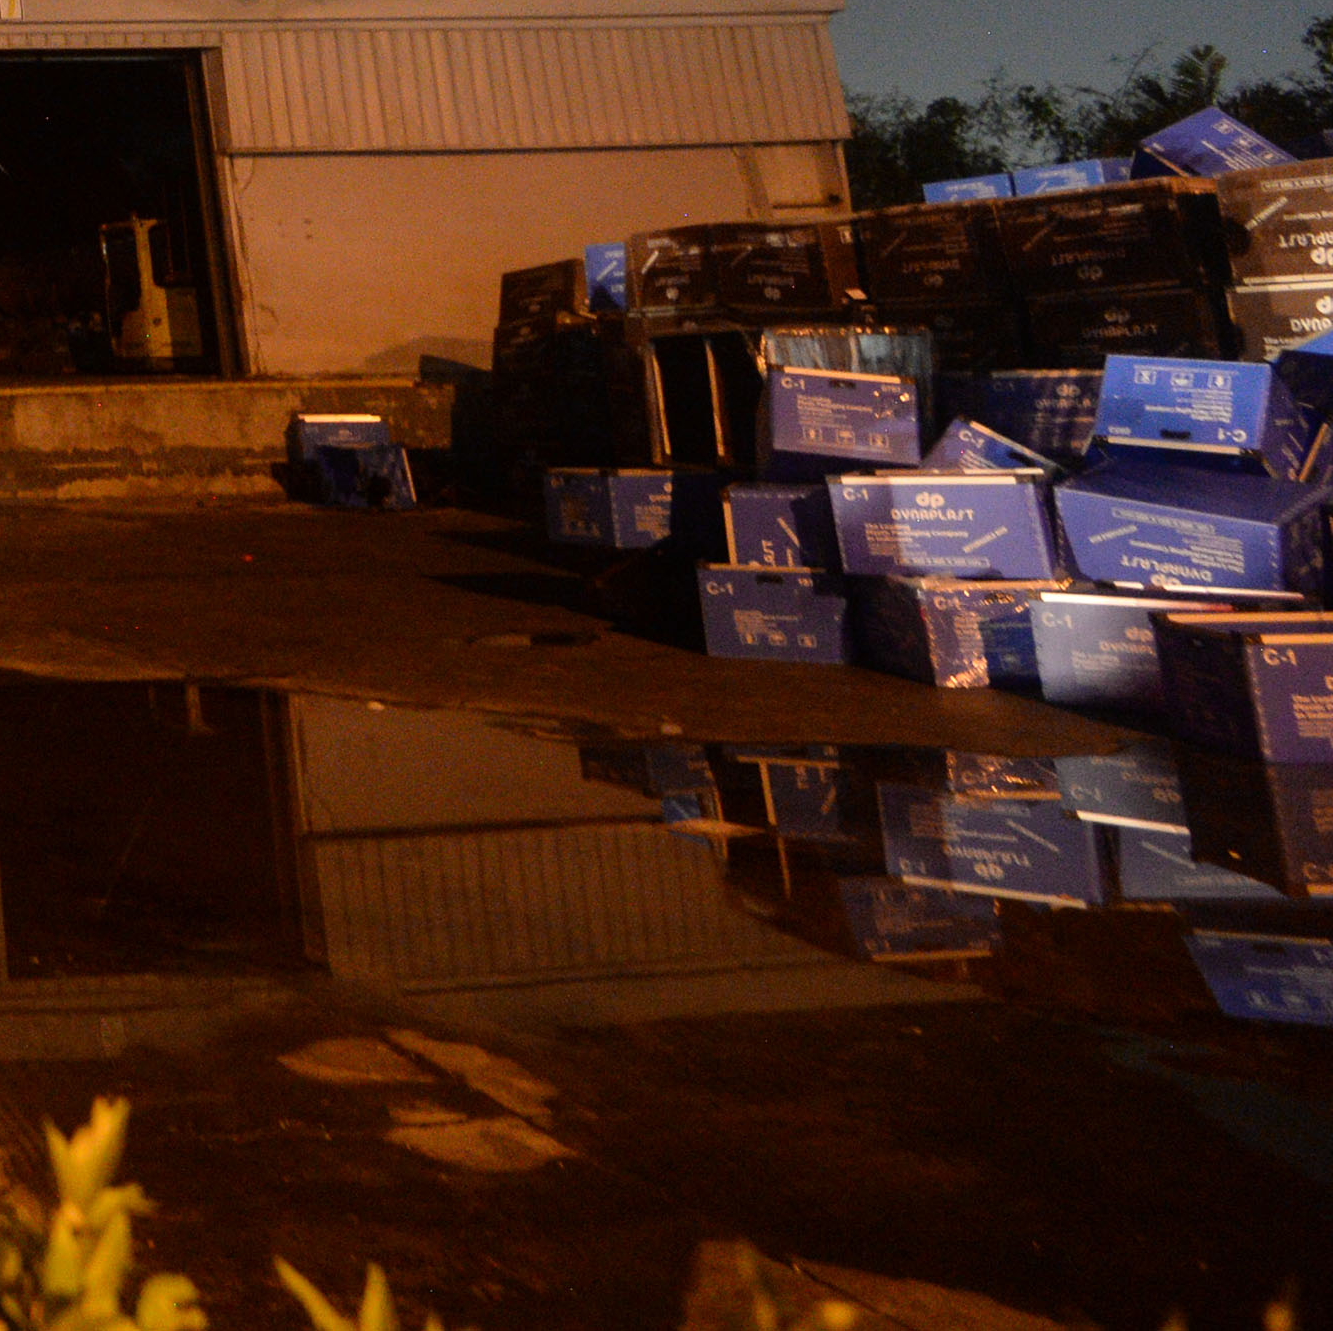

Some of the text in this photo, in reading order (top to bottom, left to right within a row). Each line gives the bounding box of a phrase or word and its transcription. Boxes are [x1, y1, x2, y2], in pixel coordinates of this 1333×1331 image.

[781, 376, 806, 390] C-1
[958, 429, 985, 449] C-1
[1217, 427, 1248, 443] C-1
[842, 487, 870, 502] C-1
[705, 580, 734, 596] C-1
[1041, 611, 1073, 629] C-1
[1262, 647, 1298, 667] C-1
